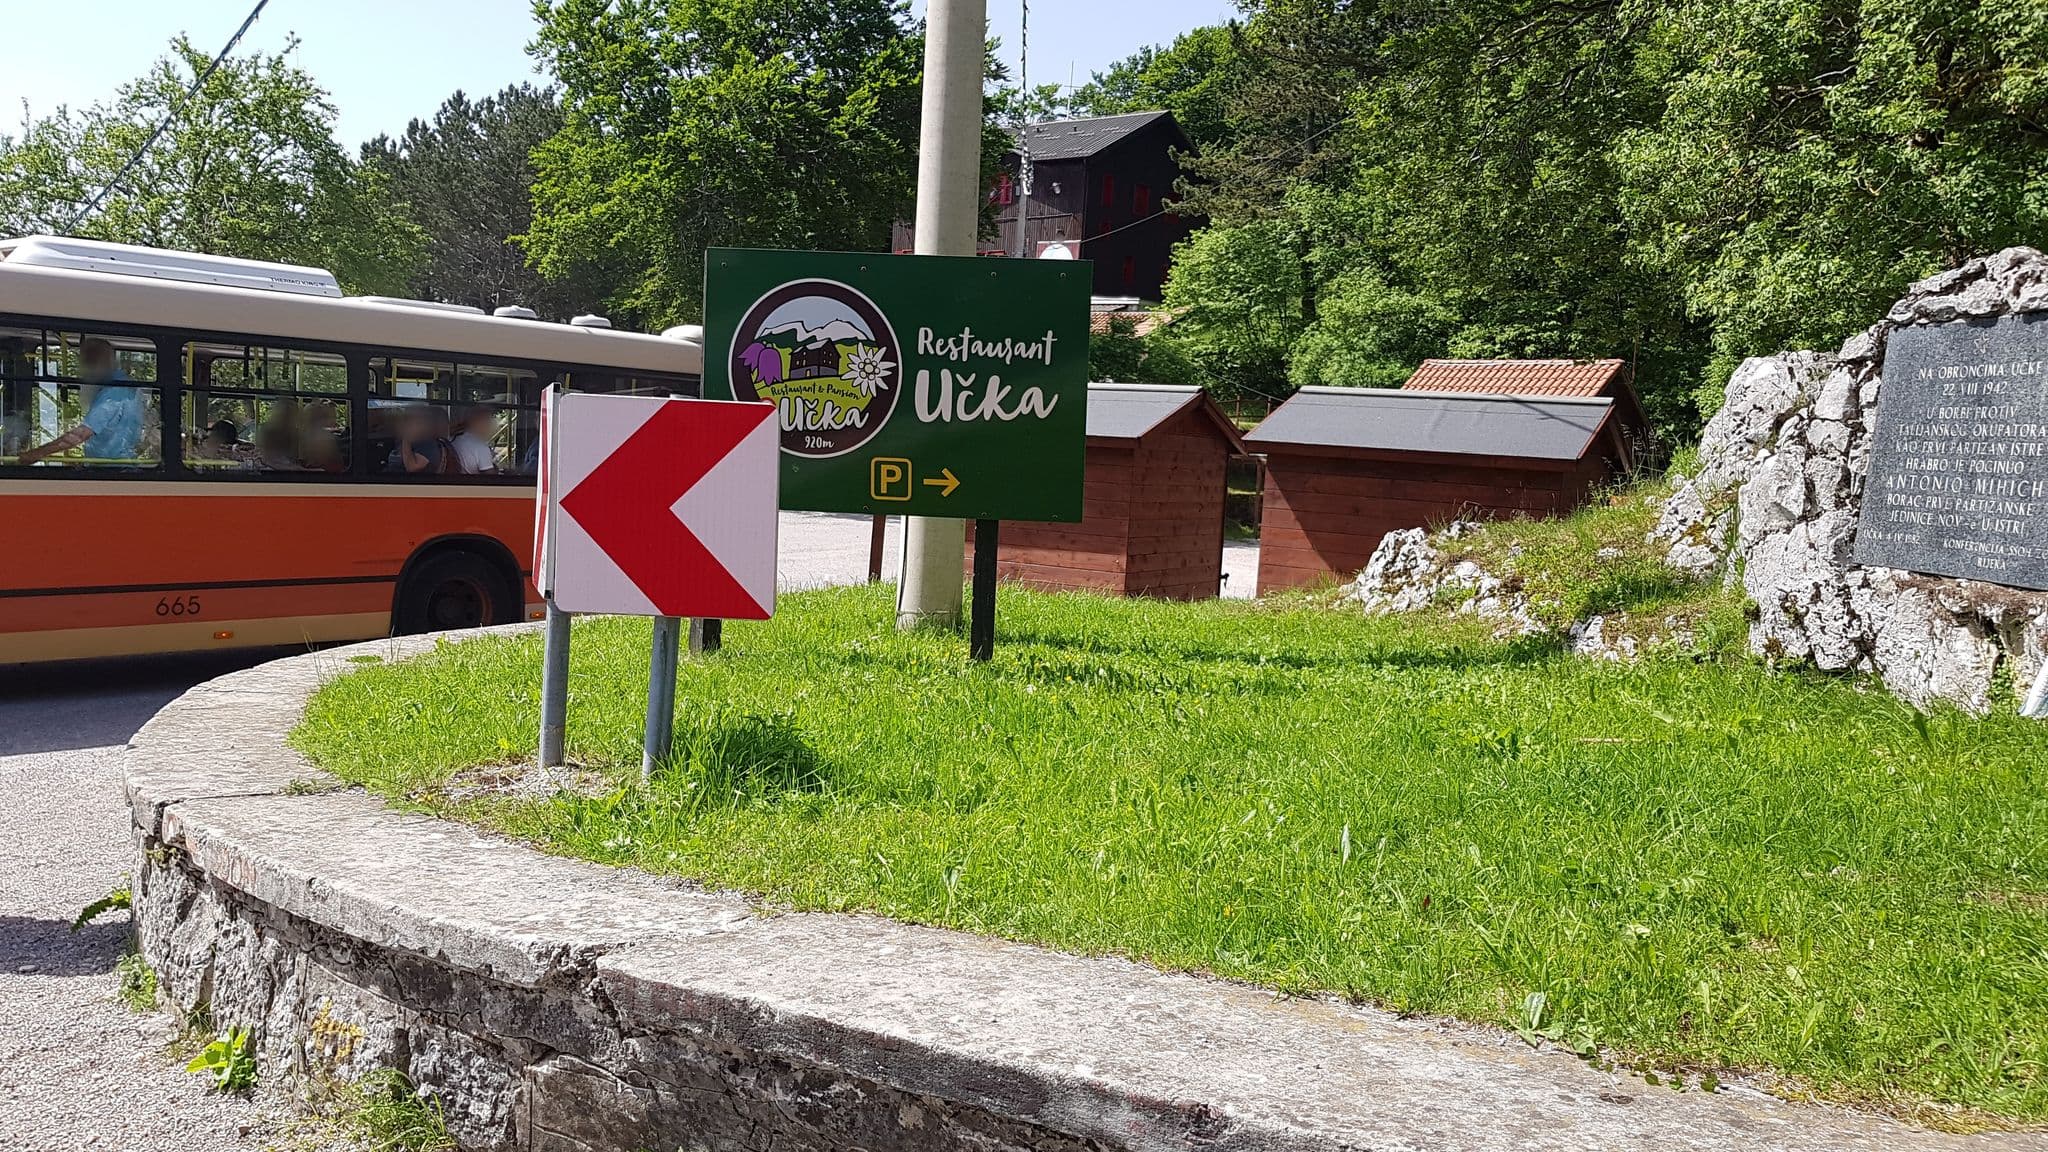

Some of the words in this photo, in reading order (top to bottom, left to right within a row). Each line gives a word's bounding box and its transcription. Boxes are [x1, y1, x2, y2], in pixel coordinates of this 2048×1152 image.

[917, 326, 1058, 366] Restaurant
[1918, 367, 1933, 380] NA
[1938, 364, 2004, 379] OBRONCIMA
[770, 382, 817, 397] Restaurant
[826, 384, 860, 400] Pansion
[914, 368, 1059, 423] Učka
[779, 396, 871, 432] Učka
[1926, 407, 1935, 419] U
[1972, 424, 2047, 438] OKUPATORA
[804, 435, 834, 449] 920m
[1949, 442, 2006, 455] PARTIZAN
[2010, 442, 2045, 456] ISTRE
[1905, 457, 1949, 472] HRABRO
[1952, 459, 1966, 472] JE
[1969, 460, 2025, 475] POGINUO
[880, 464, 902, 494] P
[1886, 475, 1963, 493] ANTONIO
[1975, 478, 2044, 498] MIHICH
[1887, 493, 1922, 506] BORAC
[1955, 498, 2035, 517] PARTIZANSKE
[1889, 510, 1934, 526] JEDINICE
[156, 595, 201, 616] 665
